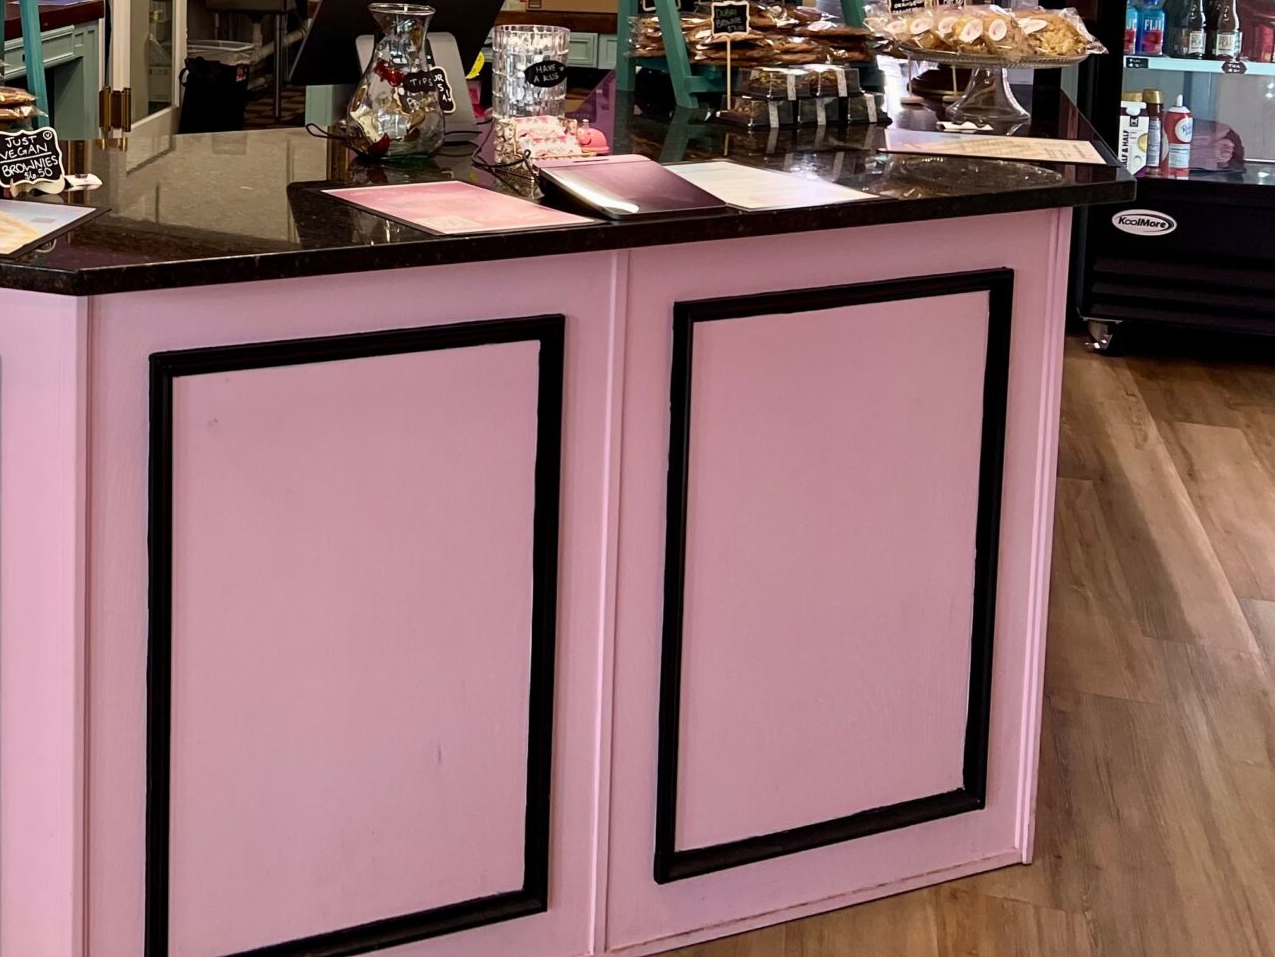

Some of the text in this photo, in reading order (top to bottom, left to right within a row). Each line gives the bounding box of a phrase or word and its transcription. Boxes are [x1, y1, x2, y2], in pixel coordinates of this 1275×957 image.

[1144, 19, 1162, 31] FIJI
[535, 64, 556, 73] HAVE
[410, 77, 433, 87] TIPS
[5, 135, 37, 148] JUST
[2, 155, 58, 177] BROWNIES
[24, 168, 53, 180] $6.50
[1118, 216, 1167, 229] KoolMore
